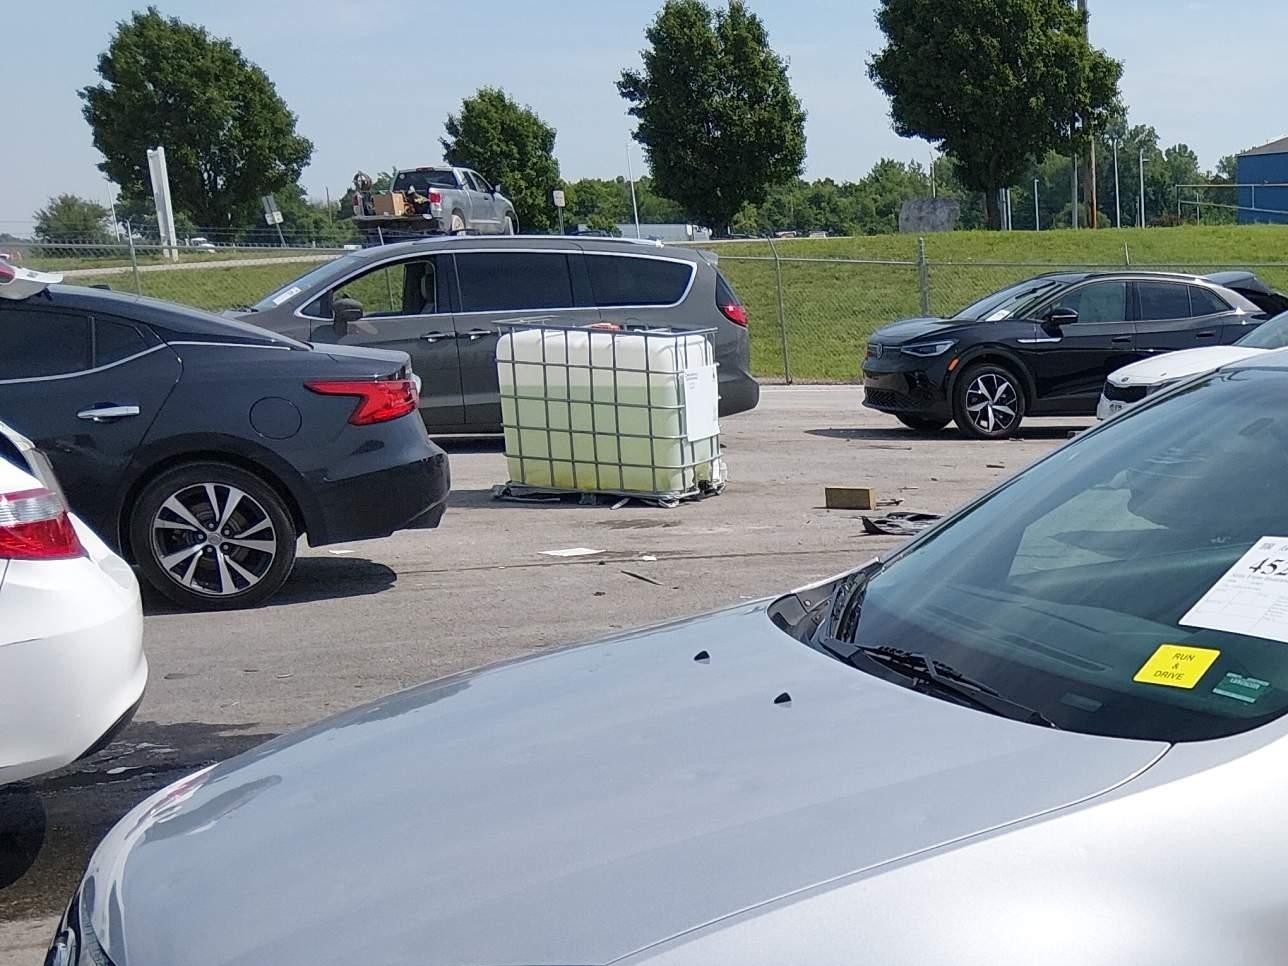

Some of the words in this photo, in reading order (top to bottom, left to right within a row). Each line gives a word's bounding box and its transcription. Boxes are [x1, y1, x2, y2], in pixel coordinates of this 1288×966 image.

[1171, 652, 1196, 662] RUN
[1171, 662, 1180, 670] &
[1153, 670, 1185, 681] DRIVE
